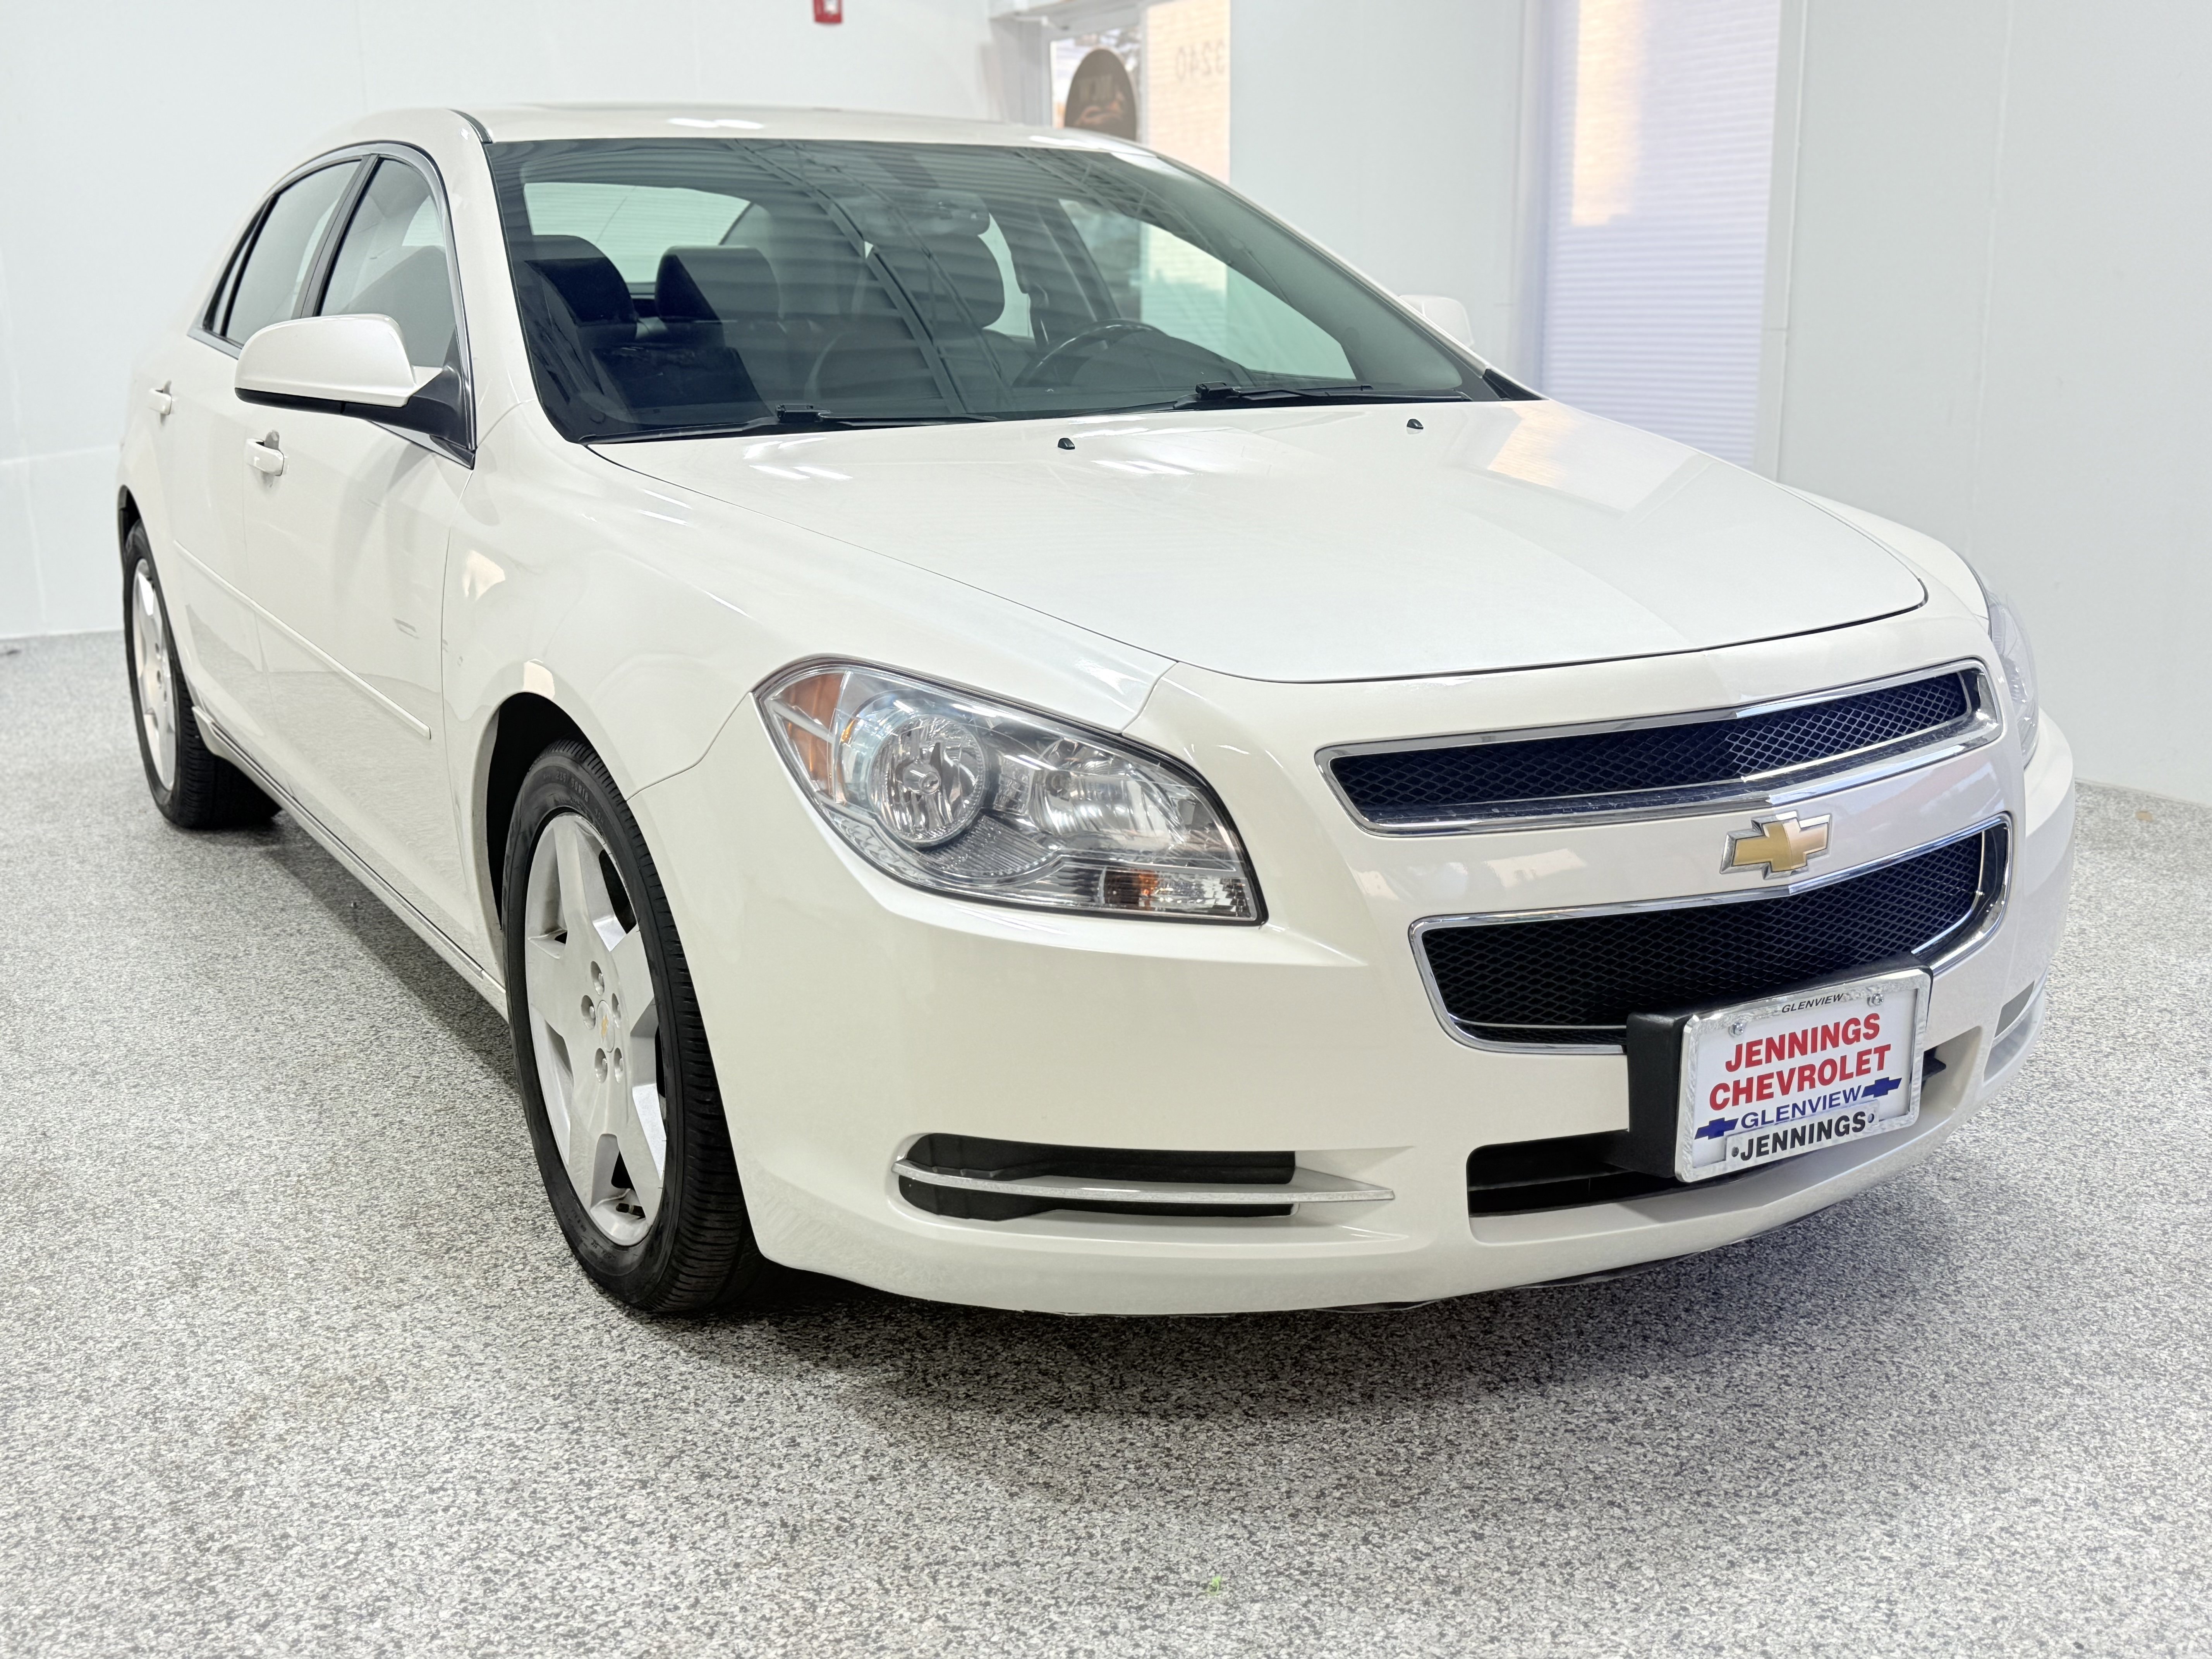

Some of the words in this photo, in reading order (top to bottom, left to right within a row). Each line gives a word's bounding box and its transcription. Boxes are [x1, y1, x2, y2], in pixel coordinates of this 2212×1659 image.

[1782, 993, 1844, 1013] GLENVIEW
[1726, 1013, 1880, 1072] JENNINGS
[1710, 1044, 1891, 1110] CHEVROLET
[1741, 1085, 1862, 1129] GLENVIEW
[1740, 1111, 1866, 1161] JENNINGS
